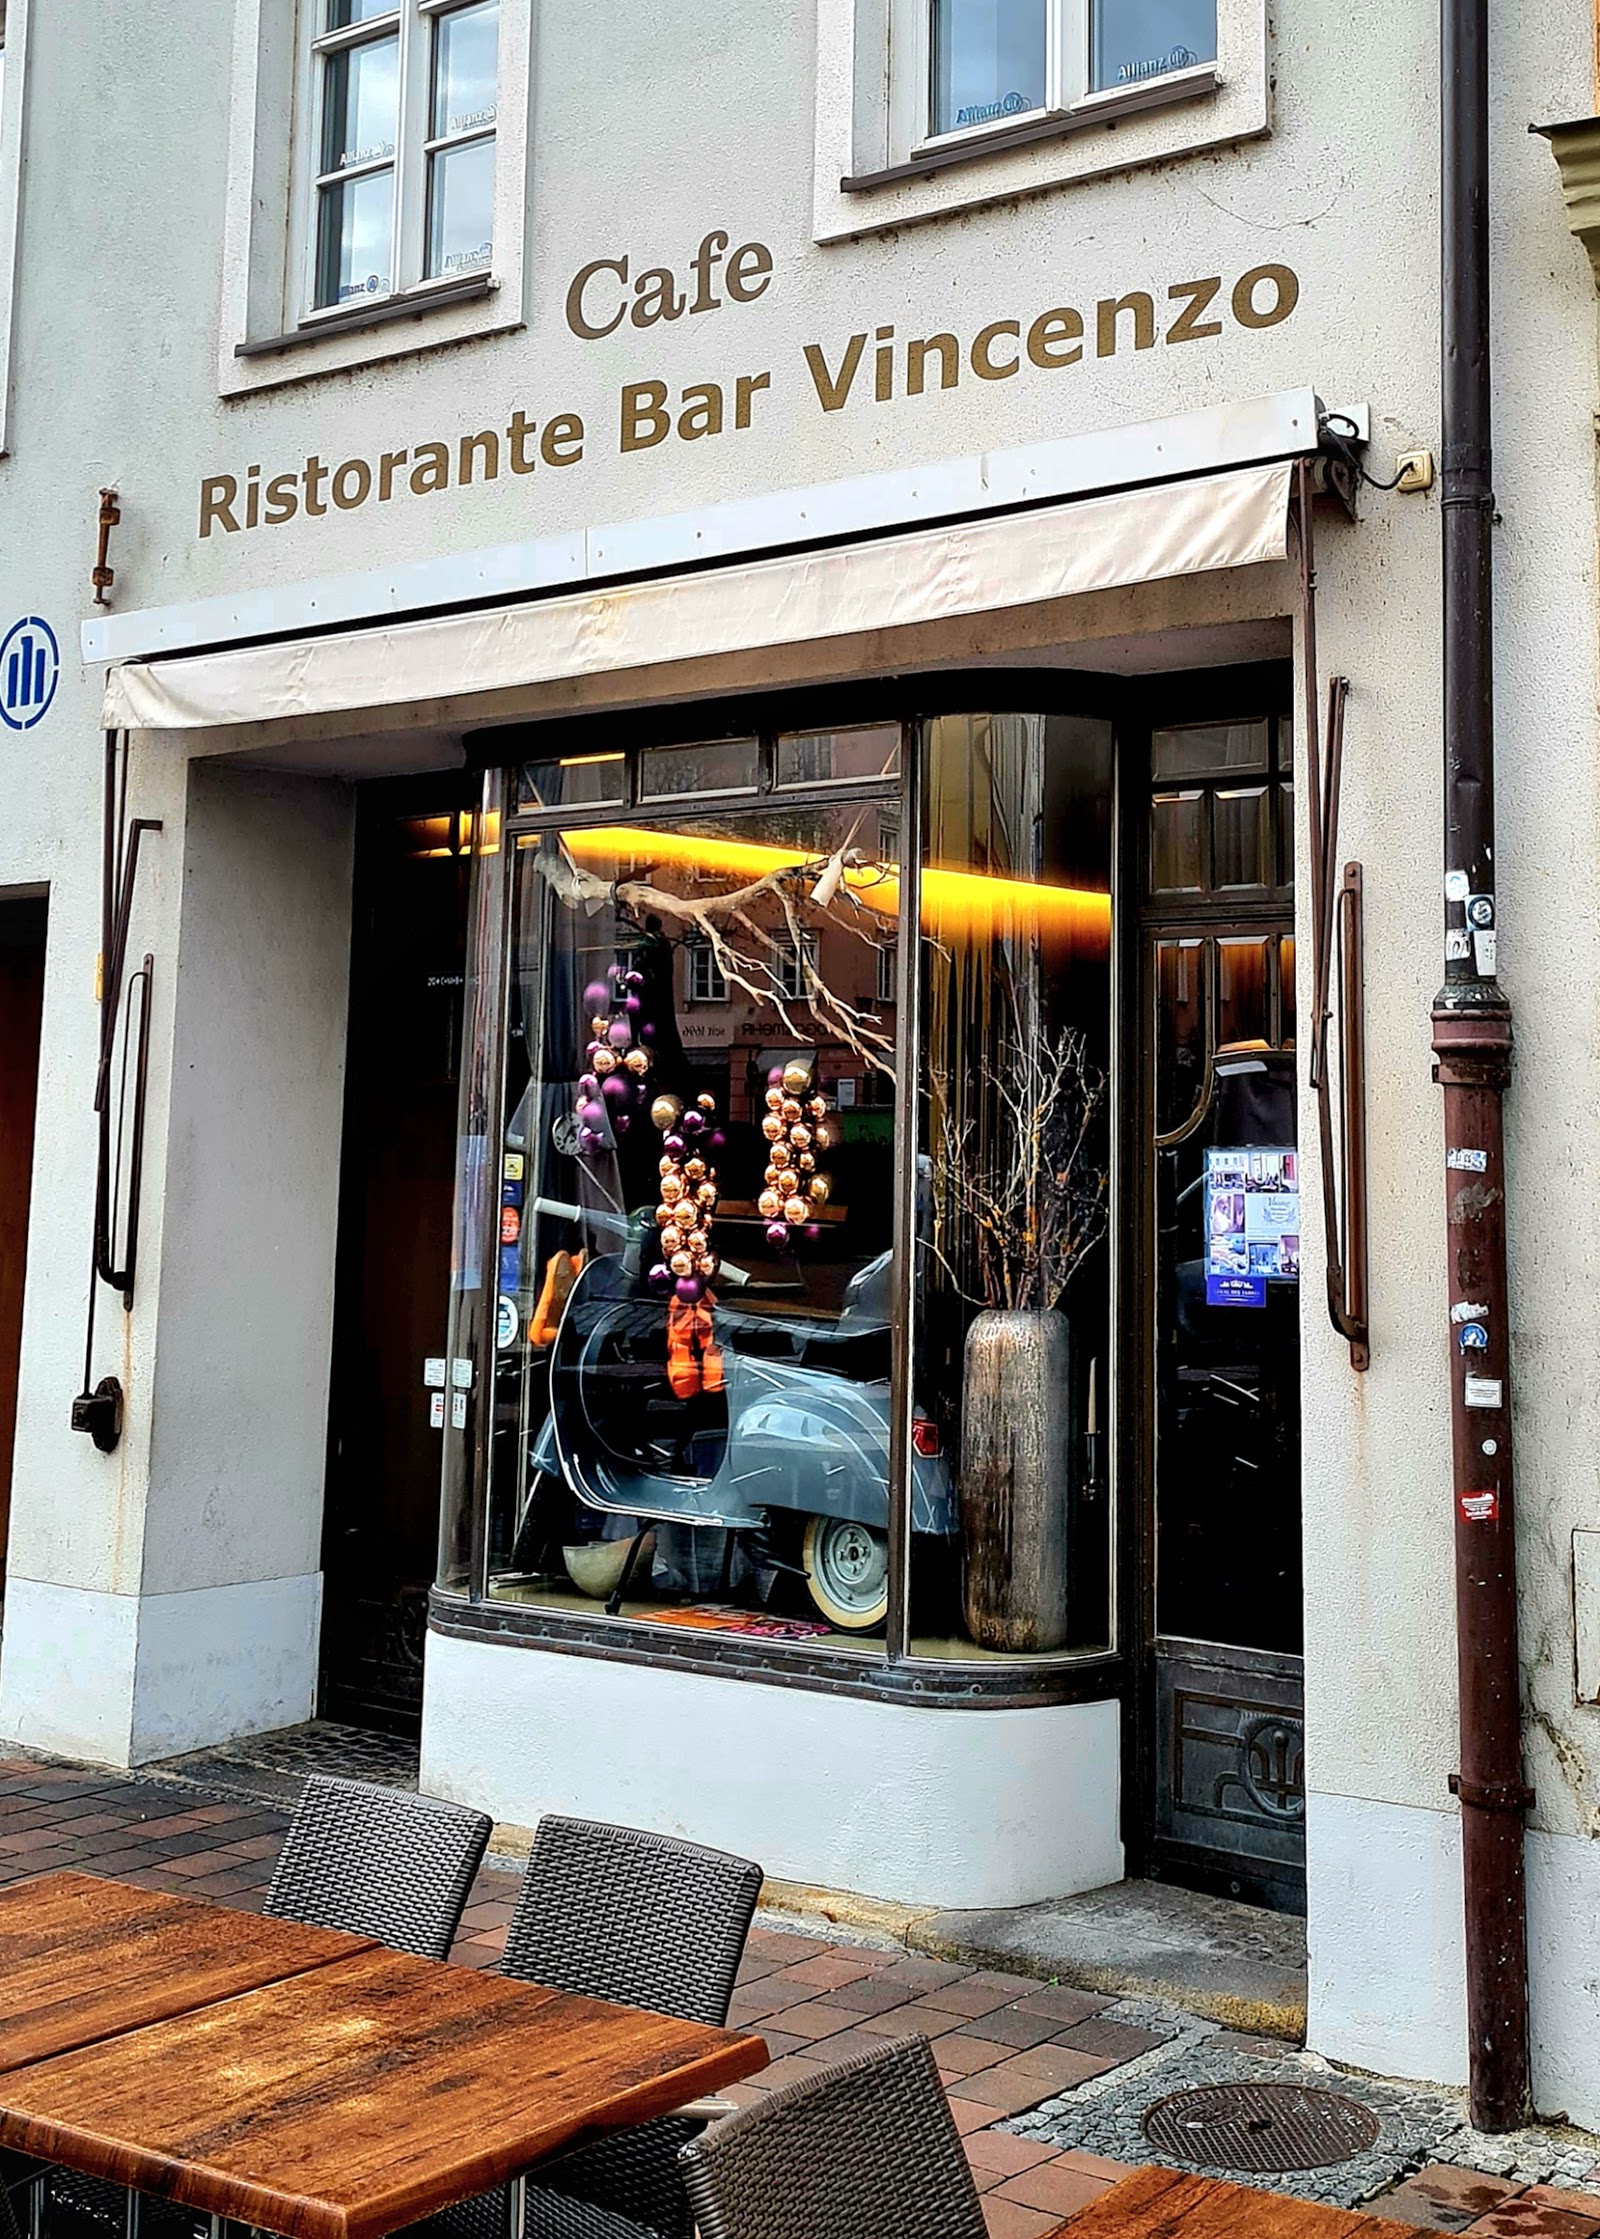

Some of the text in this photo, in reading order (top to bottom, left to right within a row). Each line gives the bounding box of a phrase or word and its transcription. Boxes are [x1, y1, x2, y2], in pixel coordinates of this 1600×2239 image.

[1118, 58, 1167, 81] Allianz
[566, 230, 774, 340] Cafe
[198, 263, 1300, 539] Ristorante Bar Vincenzo
